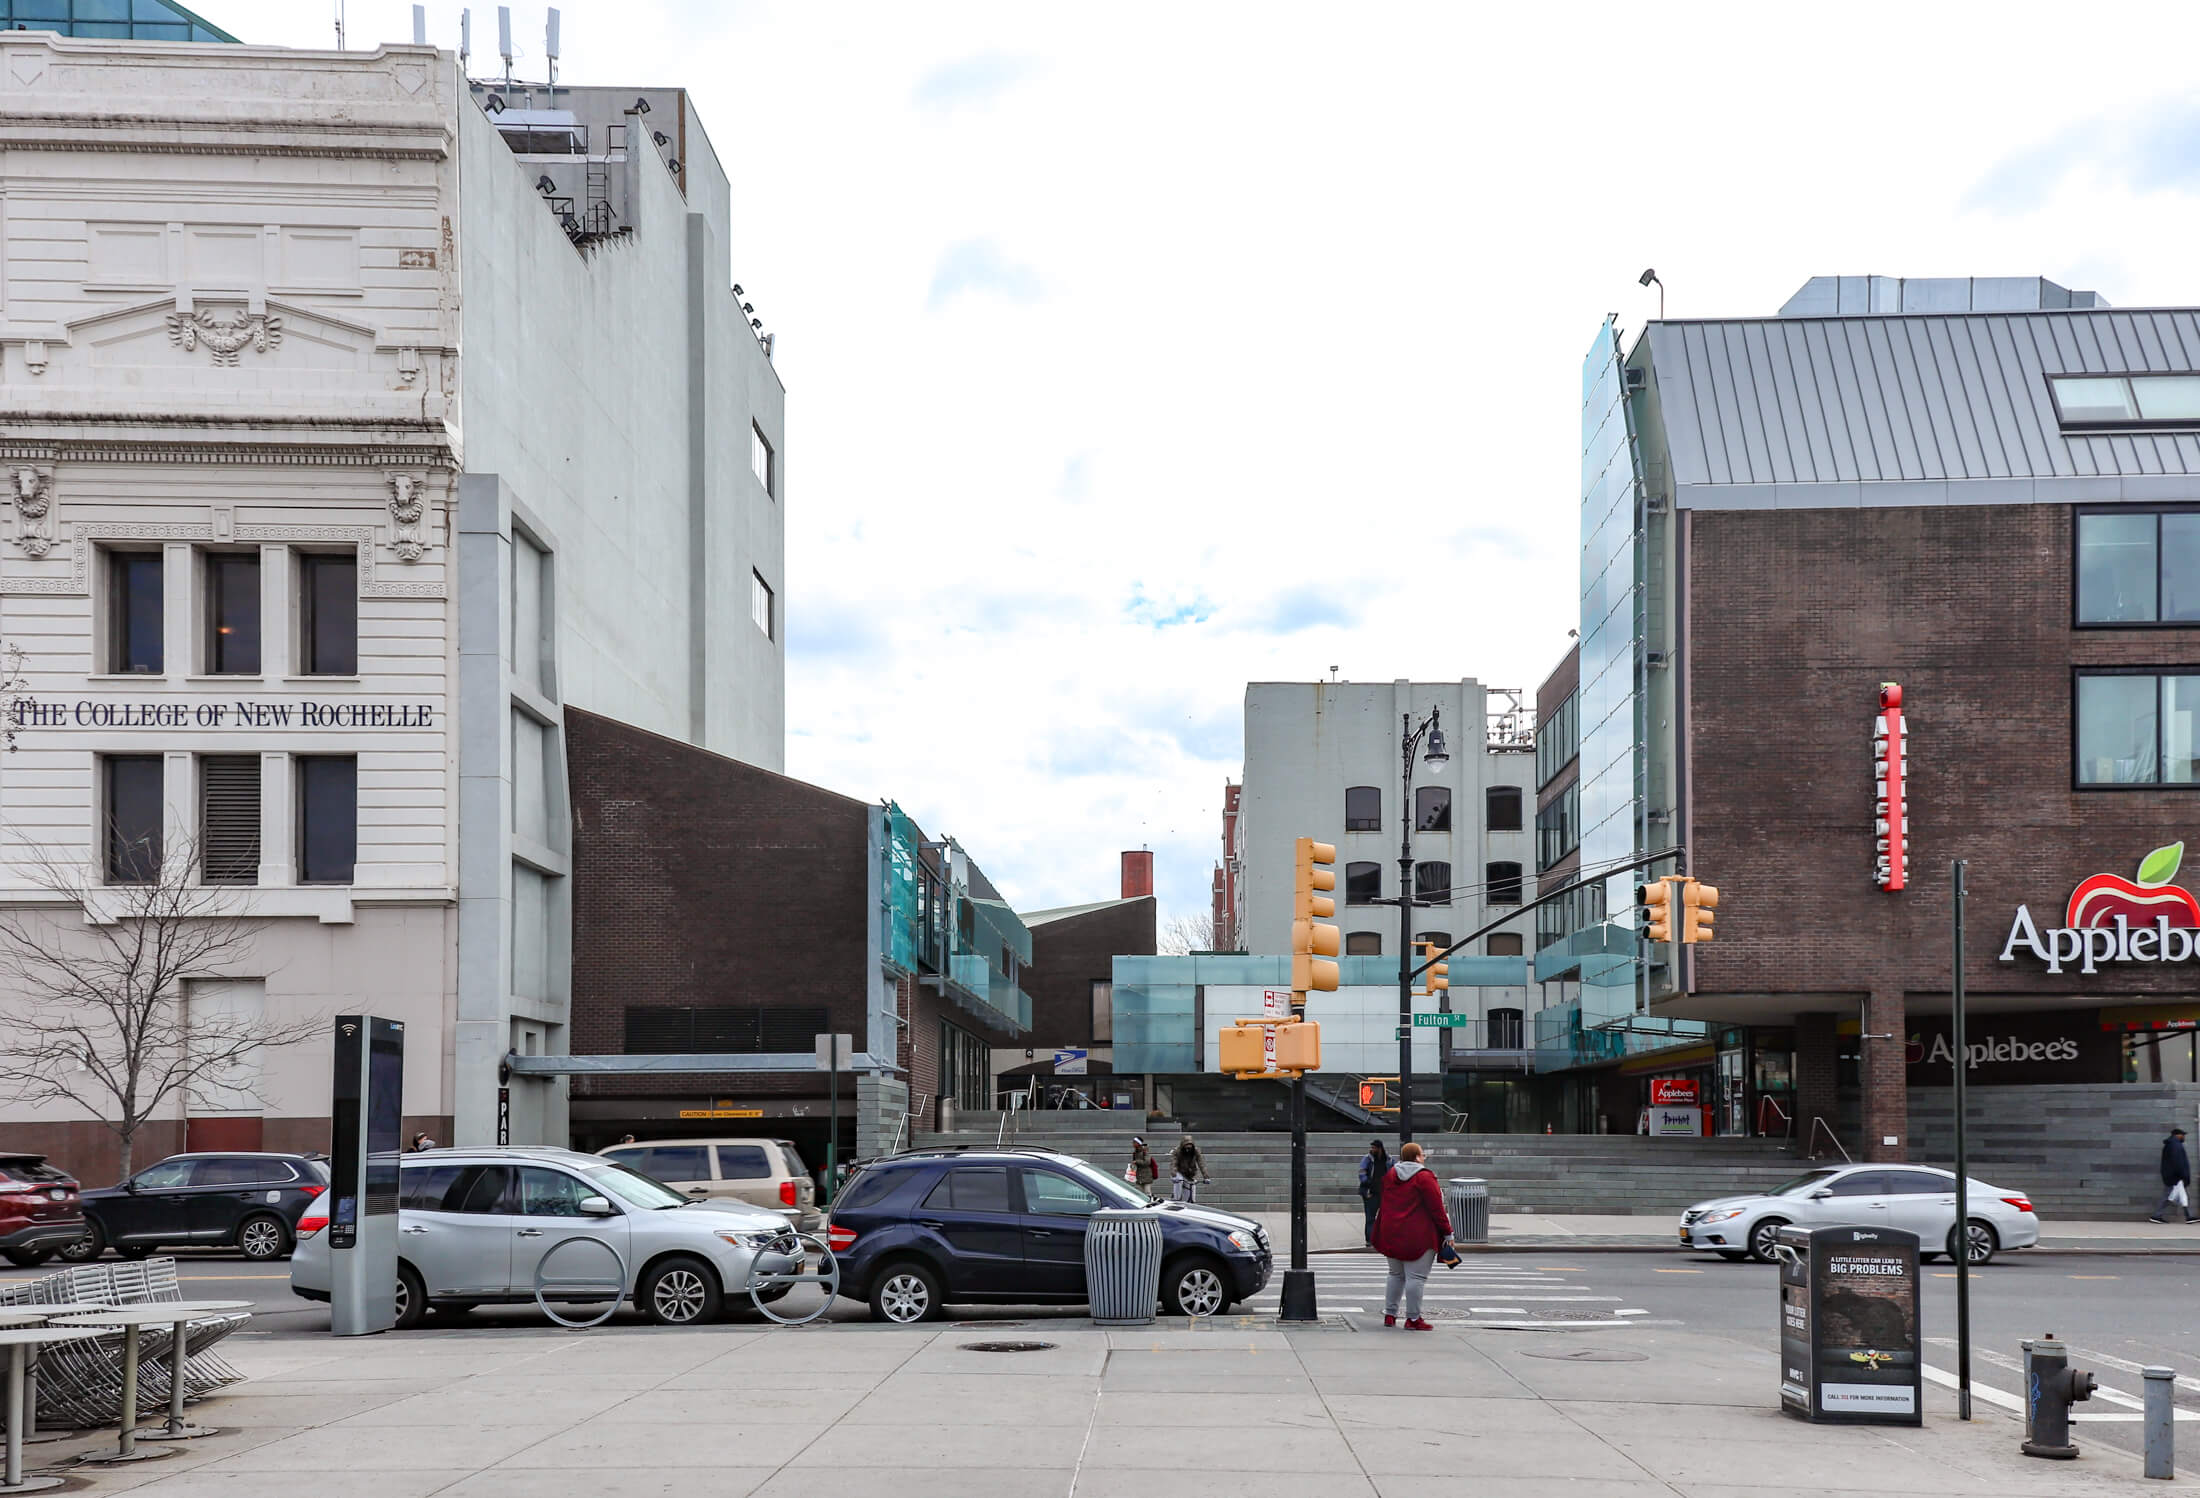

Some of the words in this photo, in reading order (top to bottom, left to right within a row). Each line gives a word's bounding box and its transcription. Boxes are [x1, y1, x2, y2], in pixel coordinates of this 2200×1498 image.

[14, 701, 67, 726] THE
[75, 701, 189, 727] COLLEGE
[196, 704, 227, 727] OF
[235, 702, 293, 727] NEW
[300, 701, 433, 727] ROCHELLE
[1999, 904, 2200, 974] Appleb
[1418, 1015, 1449, 1025] Fulton
[1830, 1263, 1847, 1273] BIG
[1850, 1264, 1903, 1276] PROBLEMS
